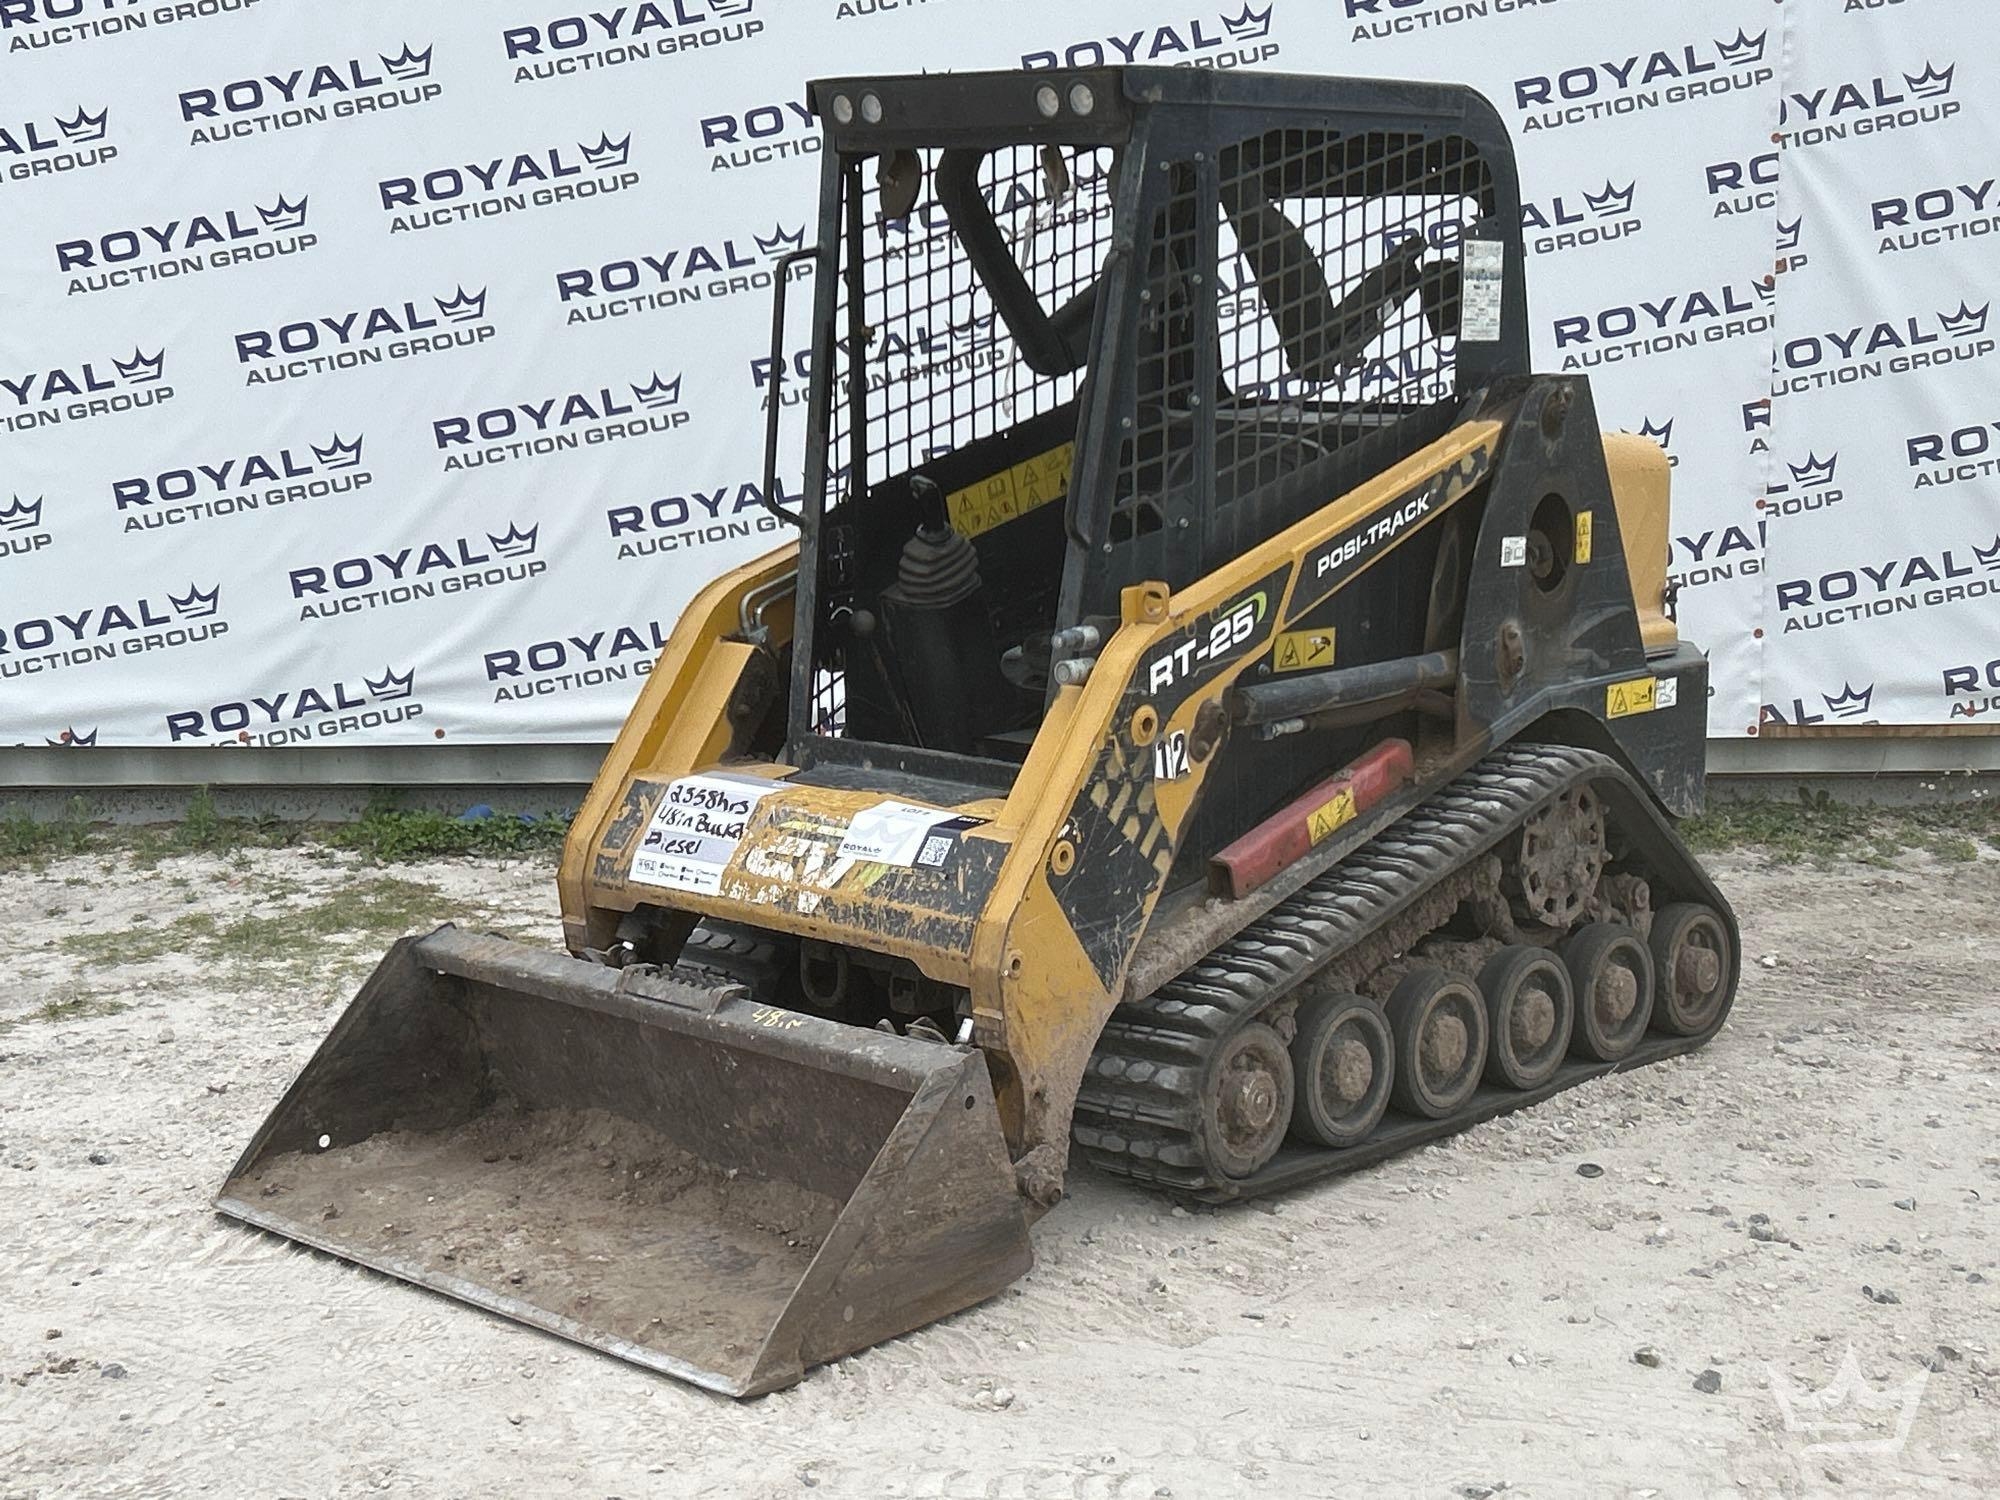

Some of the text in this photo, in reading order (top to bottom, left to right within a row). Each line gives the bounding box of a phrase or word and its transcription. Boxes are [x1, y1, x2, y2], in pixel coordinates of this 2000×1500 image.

[9, 13, 147, 53] AUCTION
[503, 0, 704, 59] ROYAL
[514, 20, 764, 83] AUCTION GROUP
[1351, 2, 1488, 42] AUCTION
[179, 60, 382, 122] ROYAL
[1514, 45, 1716, 110] ROYAL
[1522, 67, 1774, 133] AUCTION GROUP
[1780, 78, 1904, 125] YAL
[190, 83, 442, 146] AUCTION GROUP
[701, 102, 821, 148] ROY
[1853, 101, 1961, 135] GROUP
[9, 146, 118, 181] GROUP
[378, 148, 582, 210] ROYAL
[711, 136, 822, 172] AUCTIO
[390, 172, 640, 234] AUCTION GROUP
[1871, 179, 2000, 231] ROY
[56, 210, 259, 272] ROYAL
[67, 233, 318, 296] AUCTION GROUP
[1534, 218, 1641, 255] GROUP
[557, 240, 756, 302] ROYAL
[567, 263, 813, 325] AUCTION GROUP
[234, 302, 437, 363] ROYAL
[1553, 285, 1753, 348] ROYAL
[1773, 317, 1938, 373] OYAL
[246, 325, 496, 387] AUCTION GROUP
[1561, 330, 1697, 371] AUCTION
[1771, 339, 1995, 396] UCTION GROUP
[0, 364, 115, 406] YAL
[68, 386, 175, 421] GROUP
[433, 388, 633, 448] ROYAL
[444, 410, 691, 472] AUCTION GROUP
[113, 450, 313, 510] ROYAL
[124, 471, 373, 533] AUCTION GROUP
[607, 476, 804, 537] ROYAL
[617, 521, 750, 560] AUCTION
[1317, 491, 1430, 578] POSI-TRACK
[289, 538, 489, 598] ROYAL
[300, 560, 547, 622] AUCTION GROUP
[1776, 551, 1973, 611] ROYAL
[0, 599, 171, 654] OYAL
[1783, 594, 1918, 634] AUCTION
[0, 621, 229, 679] UCTION GROUP
[1149, 603, 1256, 696] RT-25
[167, 683, 366, 741] ROYAL
[494, 663, 628, 703] AUCTION
[318, 703, 423, 737] GROUP
[1157, 732, 1188, 778] 12
[644, 831, 702, 855] Diesel
[843, 843, 876, 853] ROYAL
